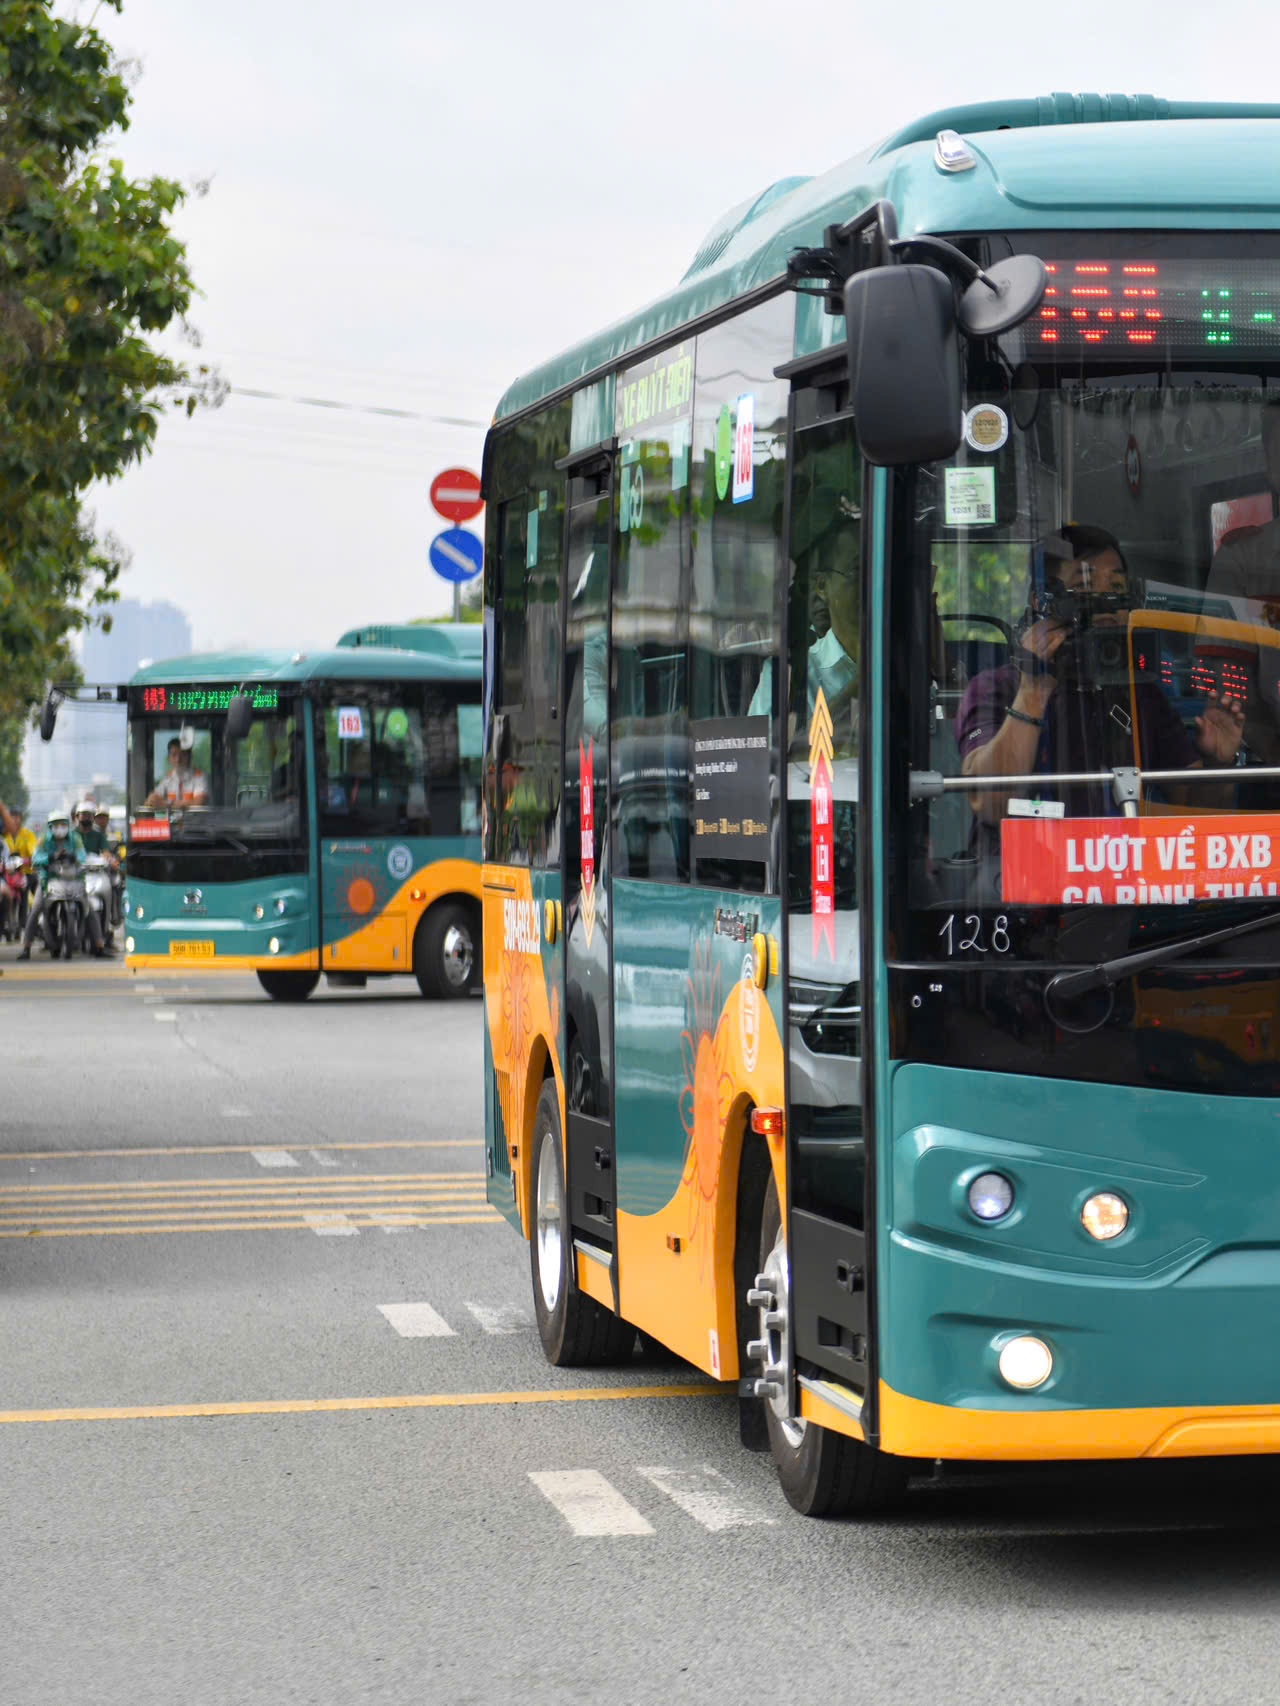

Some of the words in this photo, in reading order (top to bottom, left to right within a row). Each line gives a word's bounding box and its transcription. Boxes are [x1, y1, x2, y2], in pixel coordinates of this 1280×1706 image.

[623, 383, 638, 428] XE
[637, 358, 666, 423] BUÝT
[1066, 834, 1147, 879] LƯỢT
[1156, 825, 1196, 870] VỀ
[1207, 834, 1272, 870] BXB
[938, 914, 1011, 955] 128
